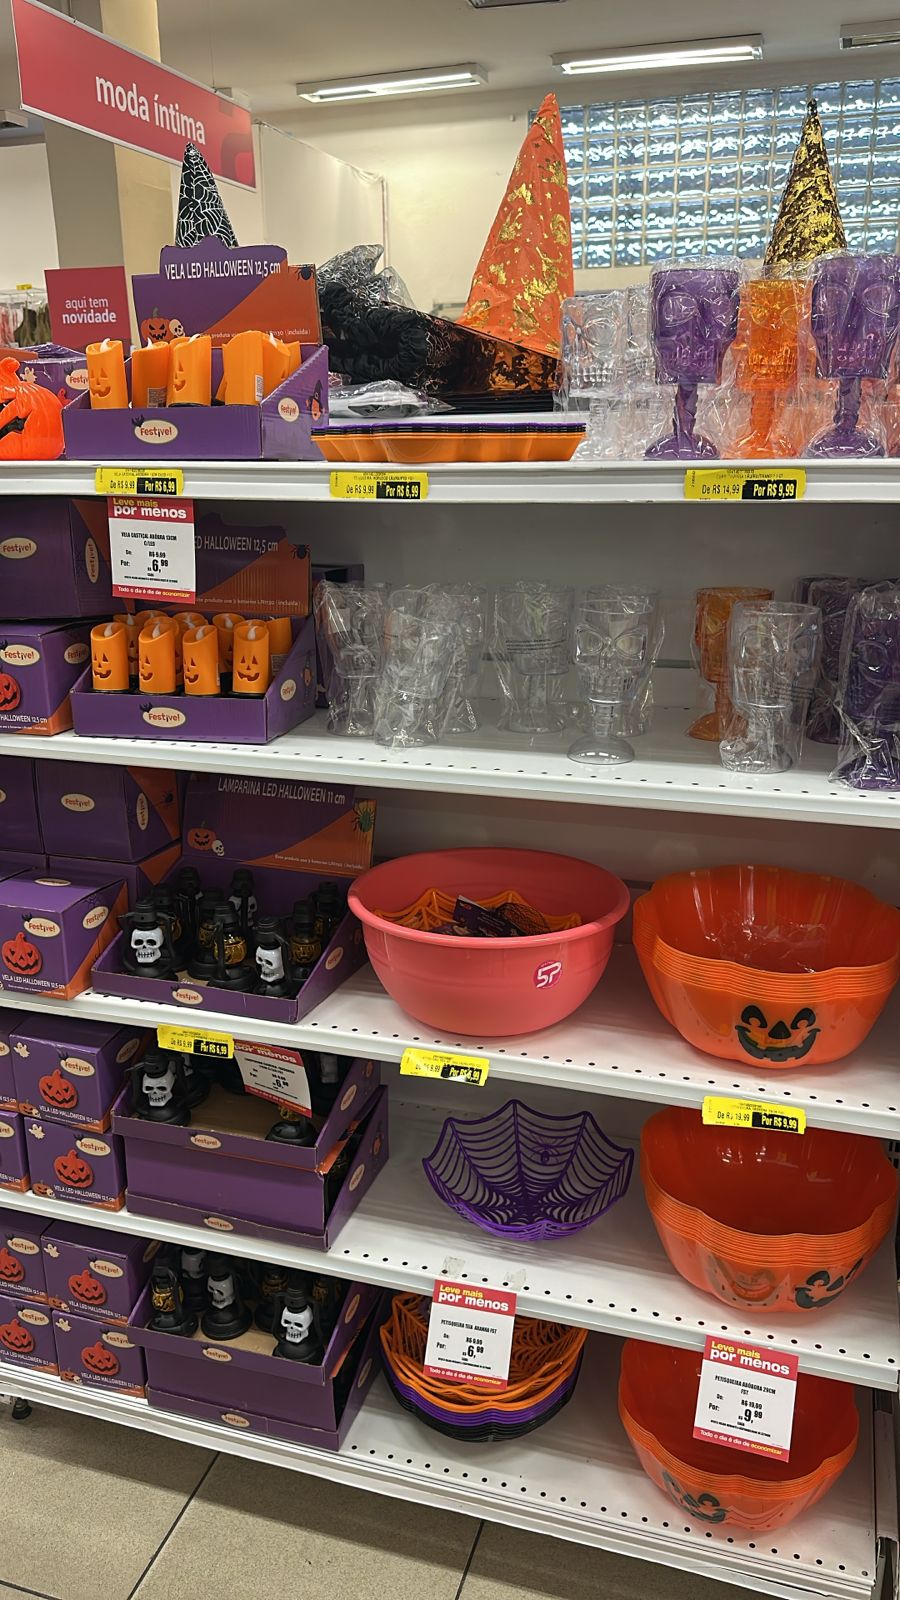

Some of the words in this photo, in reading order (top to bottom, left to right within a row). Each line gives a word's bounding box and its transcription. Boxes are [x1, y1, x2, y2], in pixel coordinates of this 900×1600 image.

[96, 76, 150, 122] moda
[154, 94, 206, 145] íntima
[165, 263, 185, 280] VELA
[187, 262, 201, 279] LED
[203, 259, 254, 278] HALLOWEEN
[254, 262, 268, 279] 12,5
[270, 262, 281, 274] cm
[65, 296, 87, 310] aqui
[89, 297, 109, 308] tem
[62, 309, 117, 324] novidade
[145, 481, 154, 492] Por
[155, 481, 162, 492] R$
[163, 481, 175, 493] 6,99
[346, 485, 353, 494] De
[385, 485, 395, 496] Por
[396, 485, 404, 498] R$
[405, 485, 419, 498] 6,99
[702, 484, 710, 494] De
[712, 484, 720, 495] R$
[723, 484, 739, 495] 14,99
[753, 484, 765, 496] Por
[767, 484, 777, 497] R$
[778, 484, 795, 498] 9,99
[113, 498, 134, 506] Leve
[137, 499, 158, 508] mais
[113, 505, 137, 516] por
[141, 507, 187, 519] menos
[204, 536, 251, 551] HALLOWEEN
[268, 542, 278, 552] cm
[218, 777, 260, 796] LAMPARINA
[262, 783, 277, 797] LED
[279, 785, 326, 802] HALLOWEEN
[334, 793, 346, 805] cm
[200, 1041, 209, 1052] Por
[257, 1049, 297, 1063] menos
[717, 1110, 724, 1119] De
[761, 1115, 772, 1126] Por
[773, 1116, 782, 1128] R$
[783, 1117, 797, 1129] 9,99
[440, 1284, 460, 1294] Leve
[462, 1289, 483, 1298] mais
[438, 1291, 462, 1303] por
[464, 1296, 509, 1312] menos
[711, 1341, 735, 1353] Leve
[737, 1346, 760, 1359] mais
[710, 1348, 737, 1362] por
[740, 1355, 790, 1375] menos
[474, 1376, 502, 1385] economizar
[700, 1429, 713, 1438] Todo
[719, 1434, 727, 1442] dia
[751, 1443, 783, 1456] economizar
